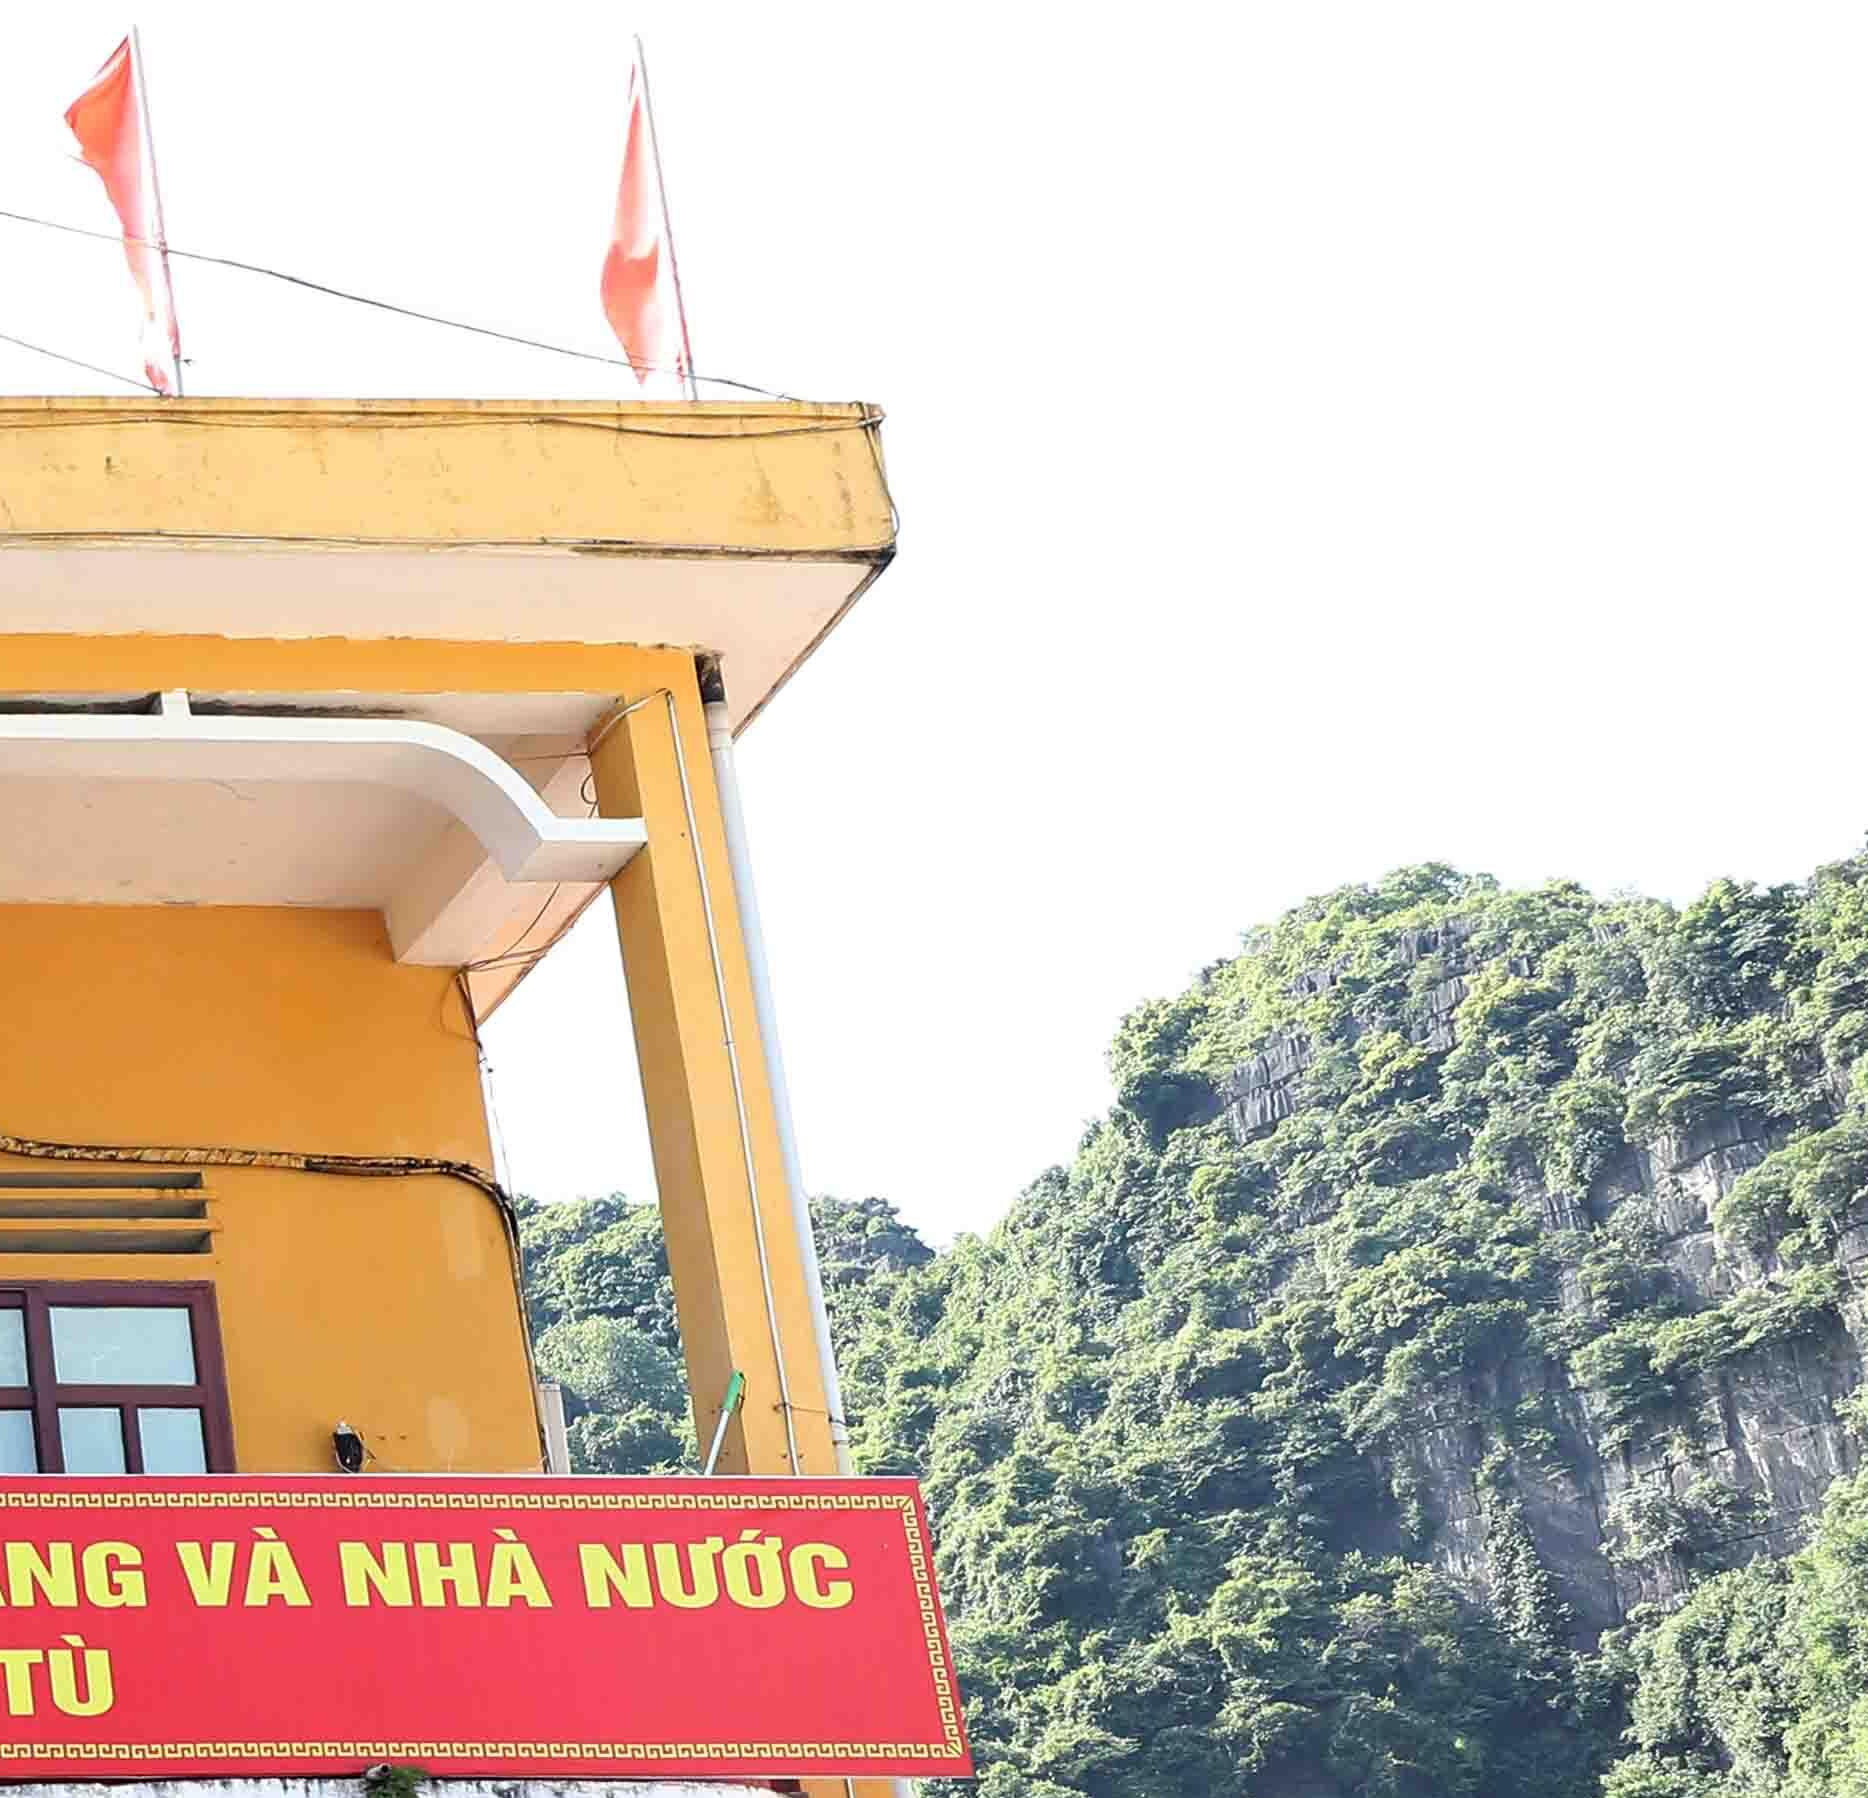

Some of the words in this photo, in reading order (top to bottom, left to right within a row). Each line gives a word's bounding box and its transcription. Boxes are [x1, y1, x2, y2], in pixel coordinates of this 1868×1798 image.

[176, 1528, 312, 1606] VÀ
[340, 1529, 553, 1608] NHÀ
[579, 1530, 853, 1608] NƯỚC
